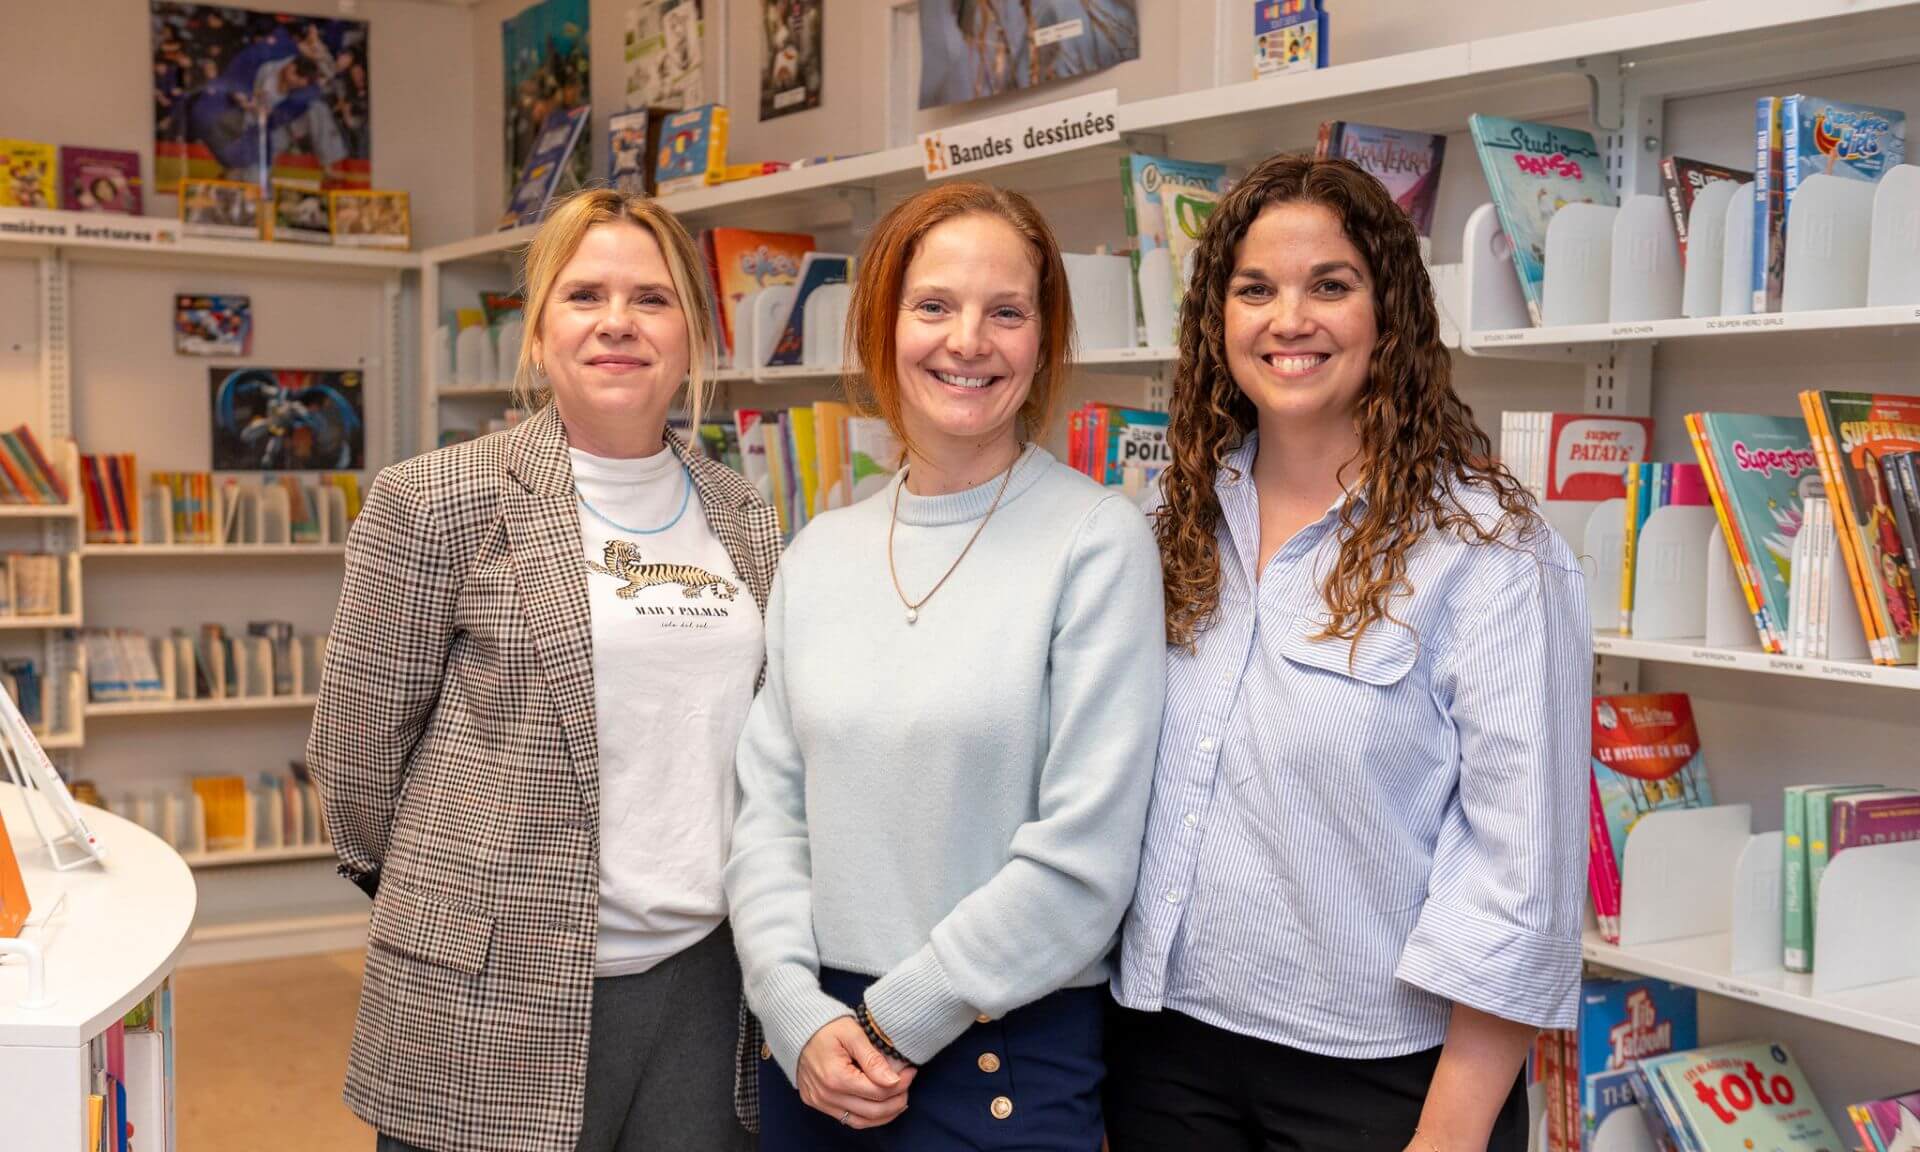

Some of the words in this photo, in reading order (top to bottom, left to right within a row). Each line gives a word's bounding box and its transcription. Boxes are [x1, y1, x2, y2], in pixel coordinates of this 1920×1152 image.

[949, 136, 1014, 166] Bandes
[1023, 111, 1116, 150] dessinées
[0, 219, 67, 236] mières
[1584, 430, 1622, 443] super
[1569, 443, 1633, 462] PATATE
[1732, 440, 1818, 479] Supergroi
[635, 606, 664, 615] MAR
[667, 606, 674, 615] Y
[679, 606, 728, 617] PALMAS
[1693, 1060, 1795, 1125] toto
